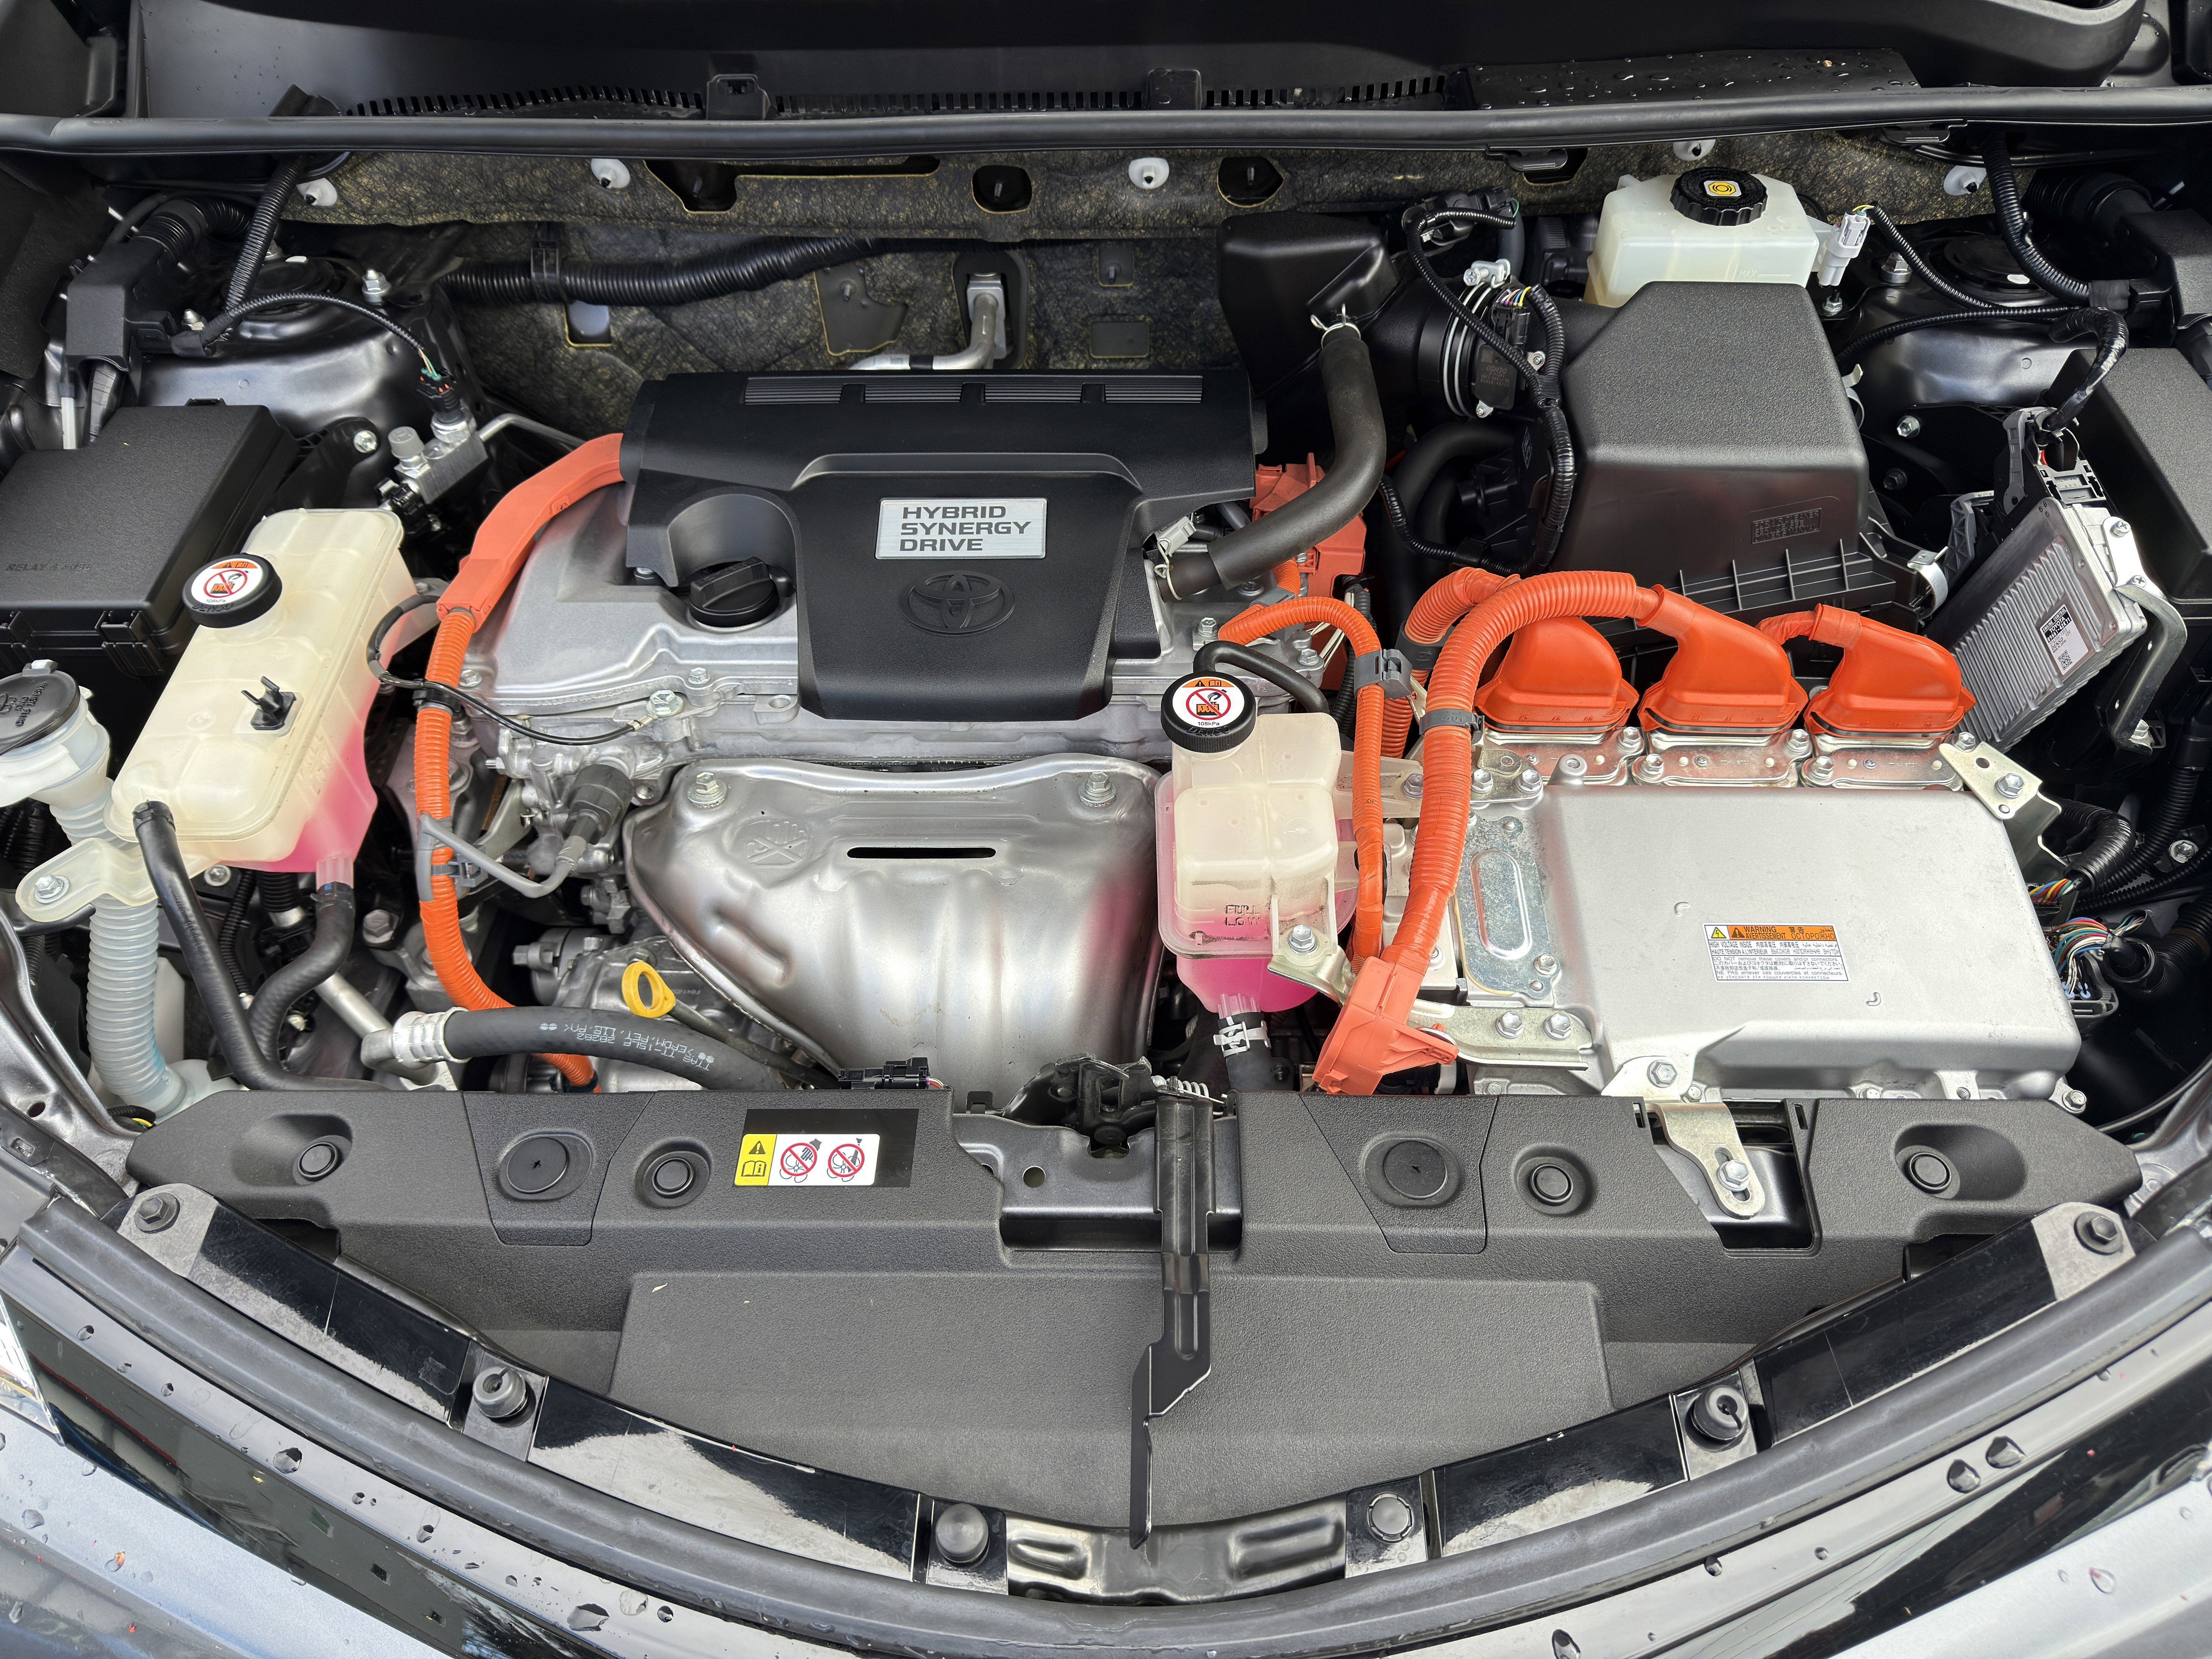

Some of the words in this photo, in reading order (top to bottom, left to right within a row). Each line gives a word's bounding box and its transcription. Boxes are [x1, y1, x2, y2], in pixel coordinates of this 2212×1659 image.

[1739, 270, 1758, 278] MAX
[902, 506, 1006, 519] HYBRID
[901, 521, 1031, 535] SYNERGY
[900, 538, 983, 551] DRIVE
[2043, 621, 2053, 632] ENGINE
[2053, 608, 2066, 622] CONTROL
[2049, 616, 2066, 633] TOYOTA
[2047, 617, 2071, 642] 89661-42K71
[2051, 637, 2063, 651] DENSO
[1186, 726, 1230, 736] DENSO
[1225, 904, 1260, 915] FULL
[1224, 916, 1260, 926] LOW
